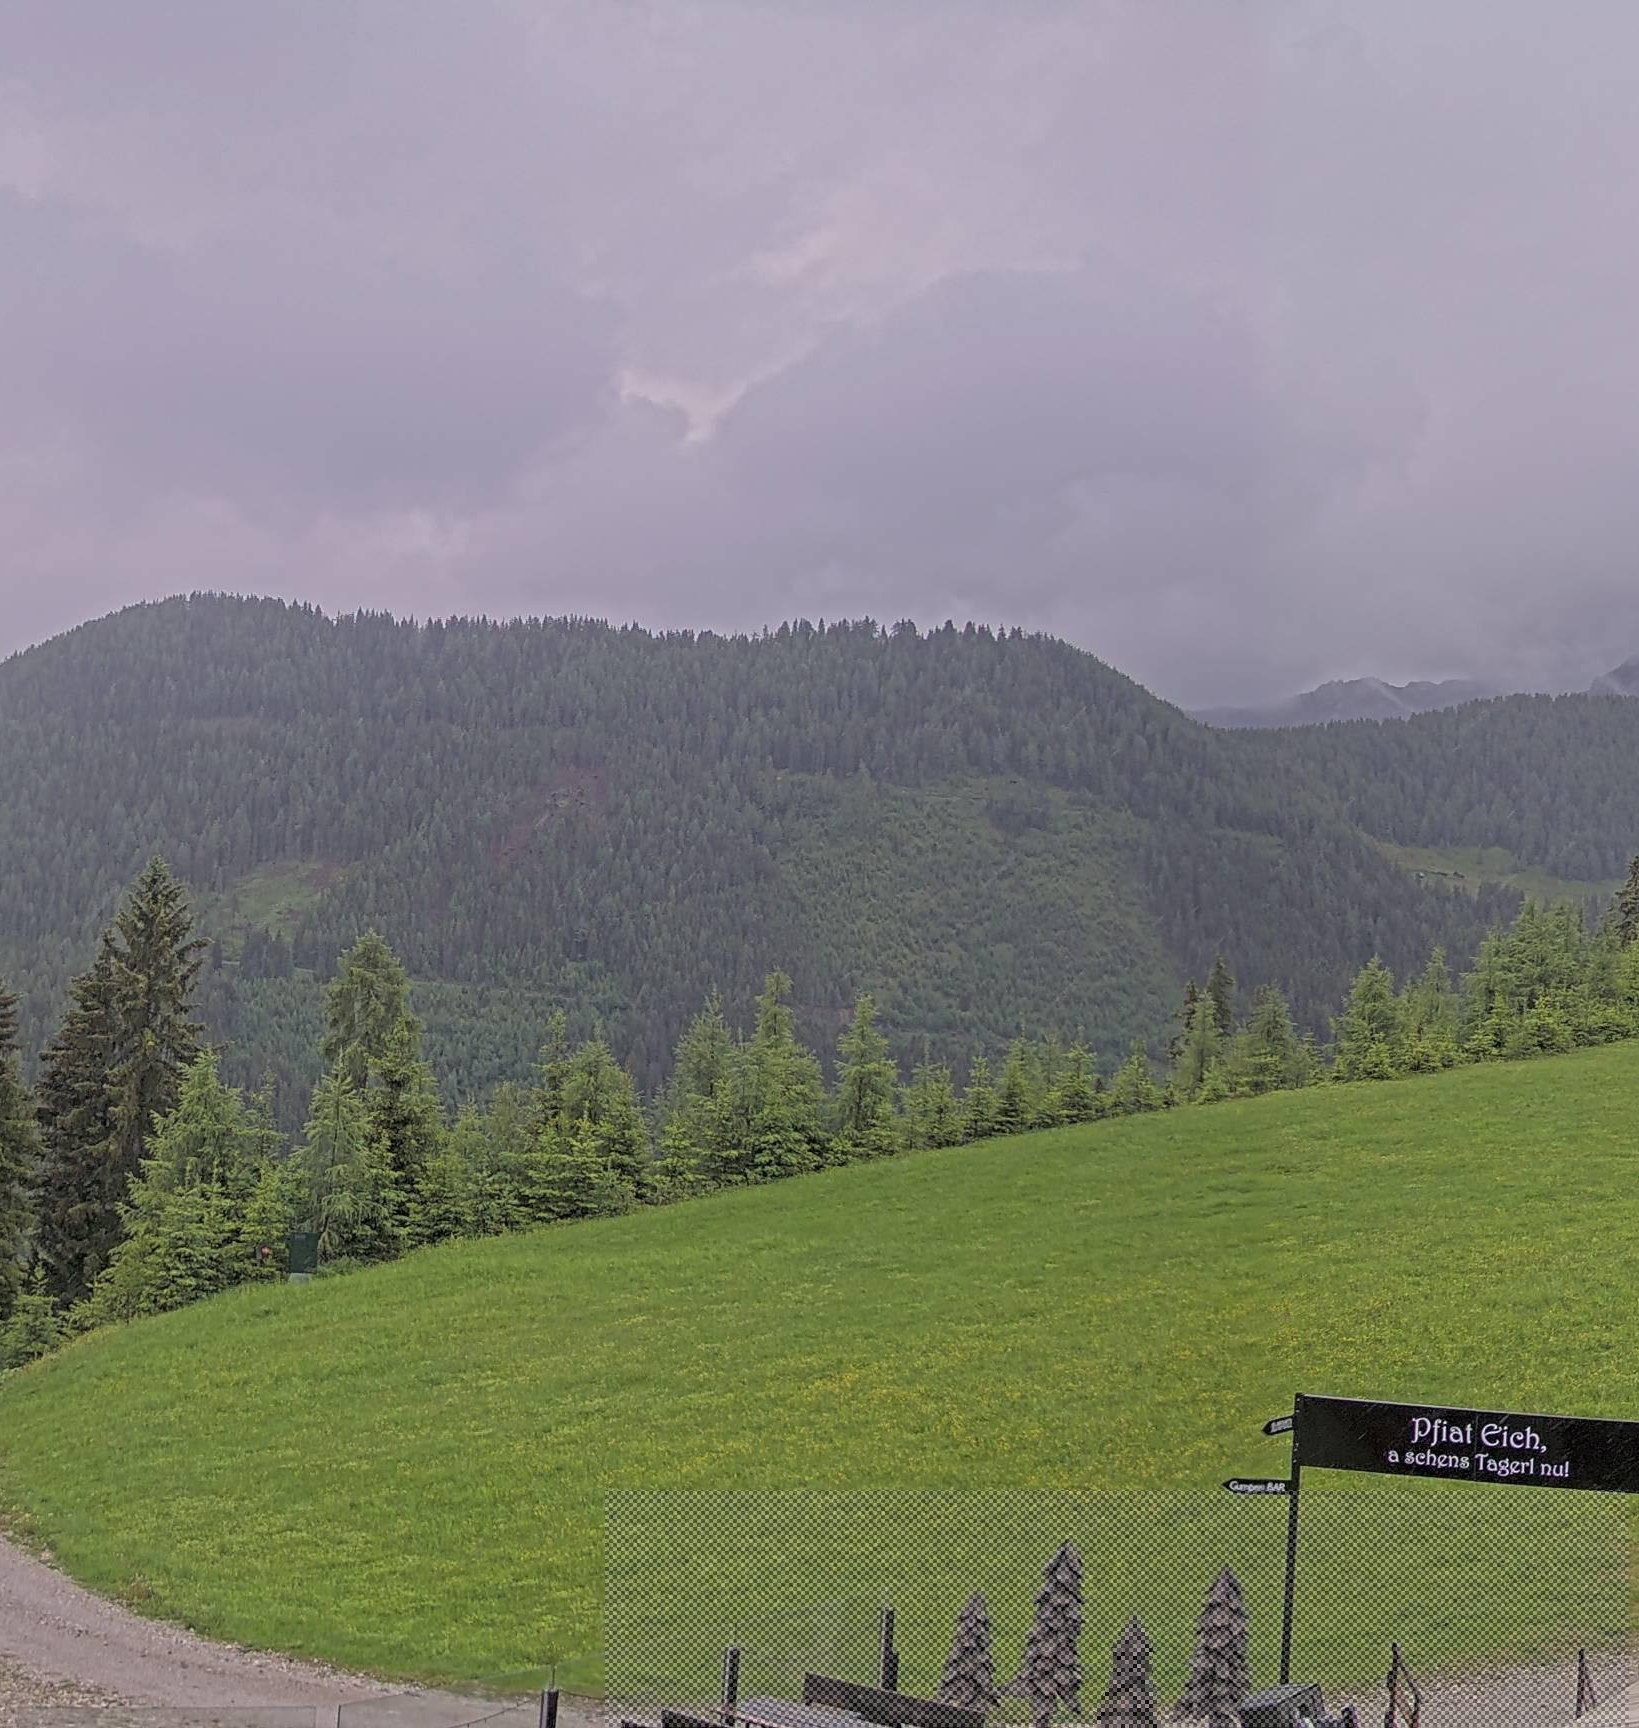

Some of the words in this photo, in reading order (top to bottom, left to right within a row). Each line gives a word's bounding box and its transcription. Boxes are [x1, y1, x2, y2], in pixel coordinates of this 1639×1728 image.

[1411, 1417, 1473, 1447] Pfiat
[1481, 1423, 1547, 1453] Eich,
[1388, 1450, 1400, 1463] a
[1404, 1449, 1470, 1469] schens
[1474, 1453, 1534, 1477] Tagerl
[1540, 1461, 1570, 1478] nu!
[1266, 1481, 1285, 1491] BAR
